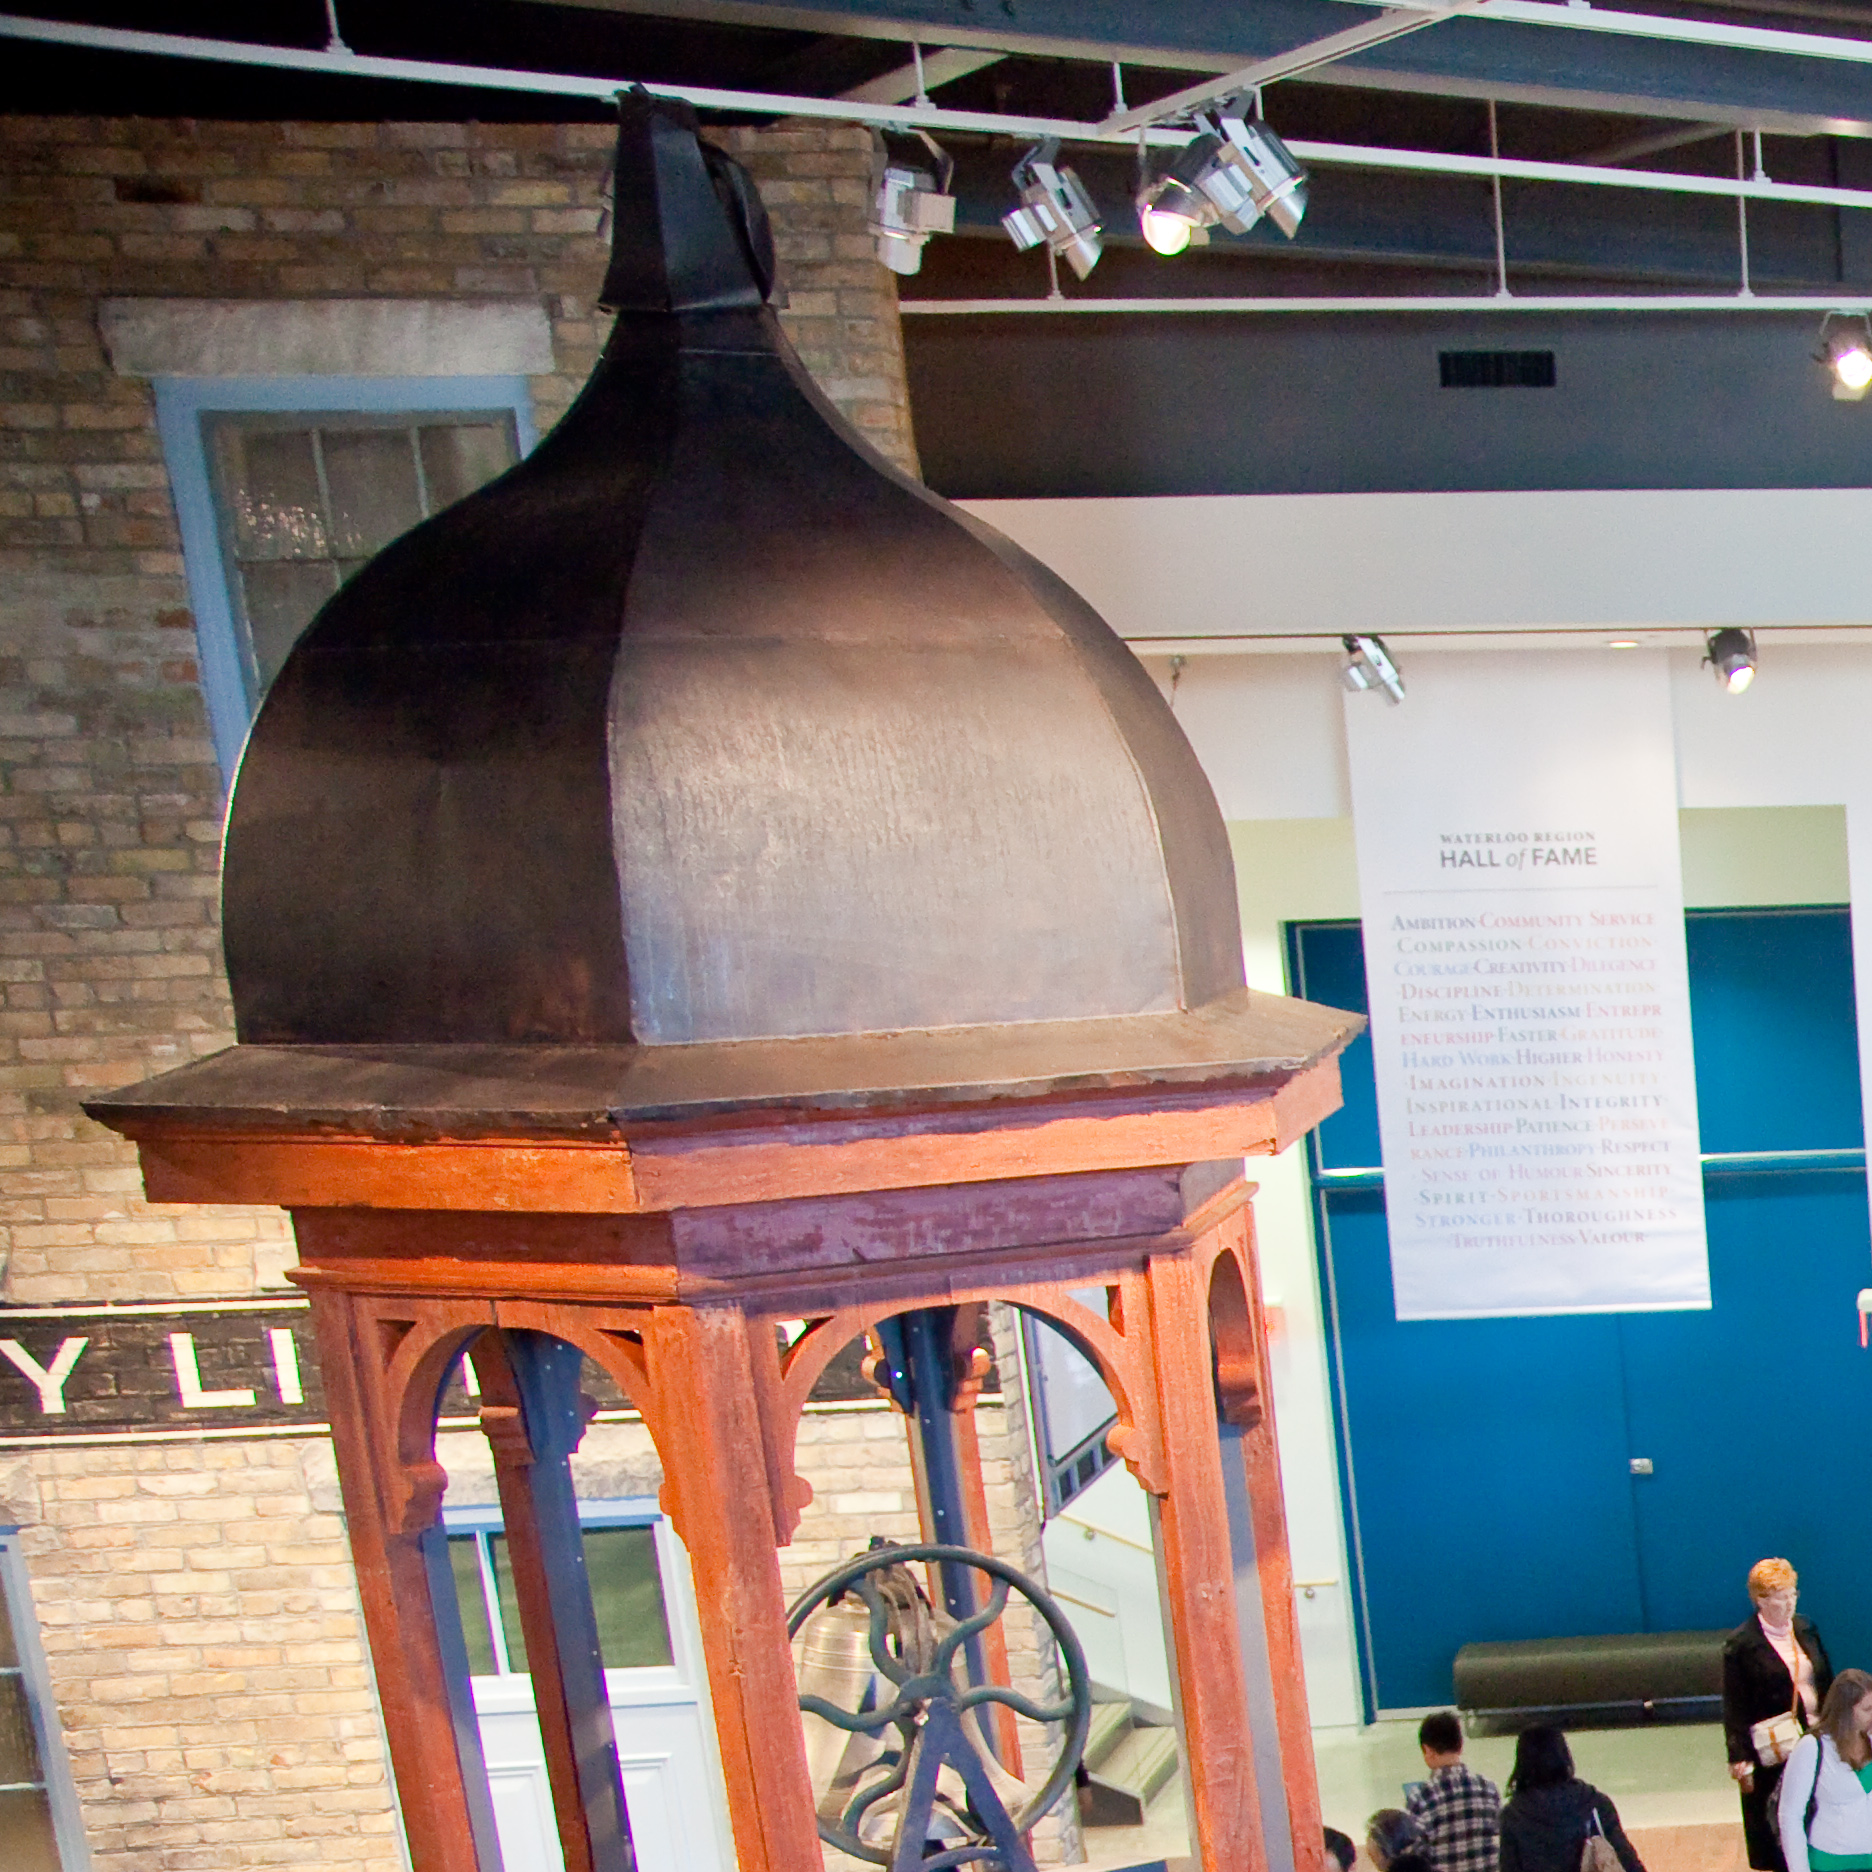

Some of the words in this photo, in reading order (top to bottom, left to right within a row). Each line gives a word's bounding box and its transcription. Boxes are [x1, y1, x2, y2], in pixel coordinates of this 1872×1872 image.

[1440, 832, 1529, 844] WATERLOO
[1534, 831, 1596, 842] REGION
[1440, 850, 1500, 868] HALL
[1506, 850, 1525, 870] of
[1532, 848, 1598, 866] FAME
[0, 1337, 89, 1414] Y
